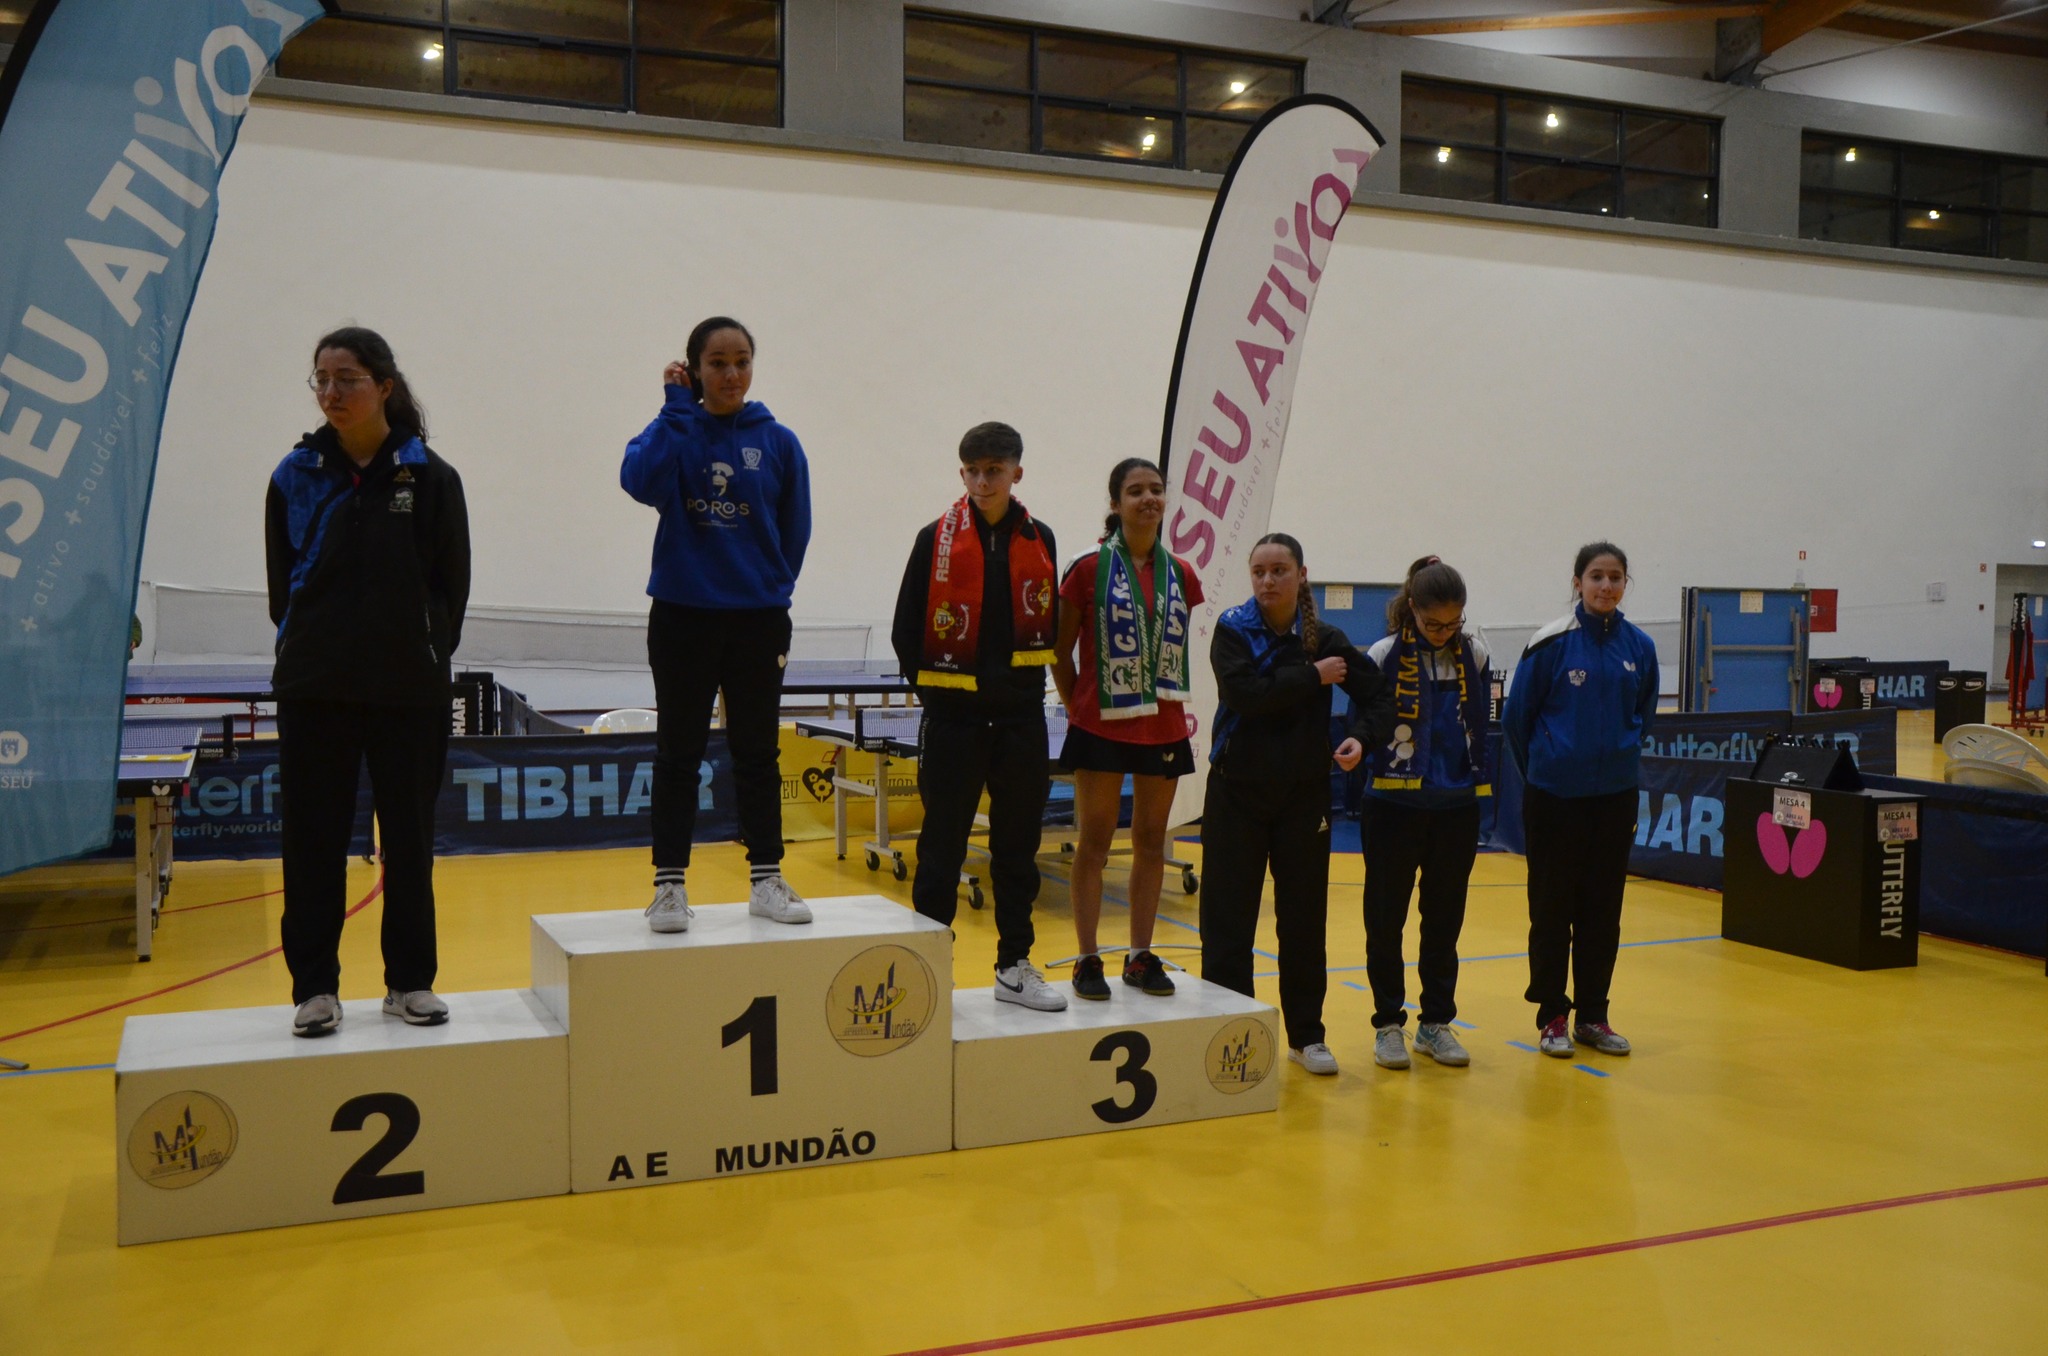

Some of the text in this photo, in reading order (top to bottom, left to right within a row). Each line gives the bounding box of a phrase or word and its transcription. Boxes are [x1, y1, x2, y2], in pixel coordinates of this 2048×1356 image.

[33, 540, 69, 606] ativo
[77, 391, 135, 505] saudável
[137, 313, 173, 370] feliz
[935, 505, 960, 582] ASSOCIA
[1206, 568, 1225, 617] ativo
[1230, 454, 1262, 542] saudável
[1138, 604, 1150, 668] Mirandela
[155, 696, 185, 704] Butterfly
[1641, 732, 1765, 763] Butterfly
[1779, 797, 1799, 807] MESA
[1884, 811, 1905, 821] MESA
[720, 995, 779, 1097] 1
[1089, 1030, 1158, 1124] 3
[330, 1091, 425, 1205] 2
[608, 1126, 877, 1182] A E MUNDÃO
